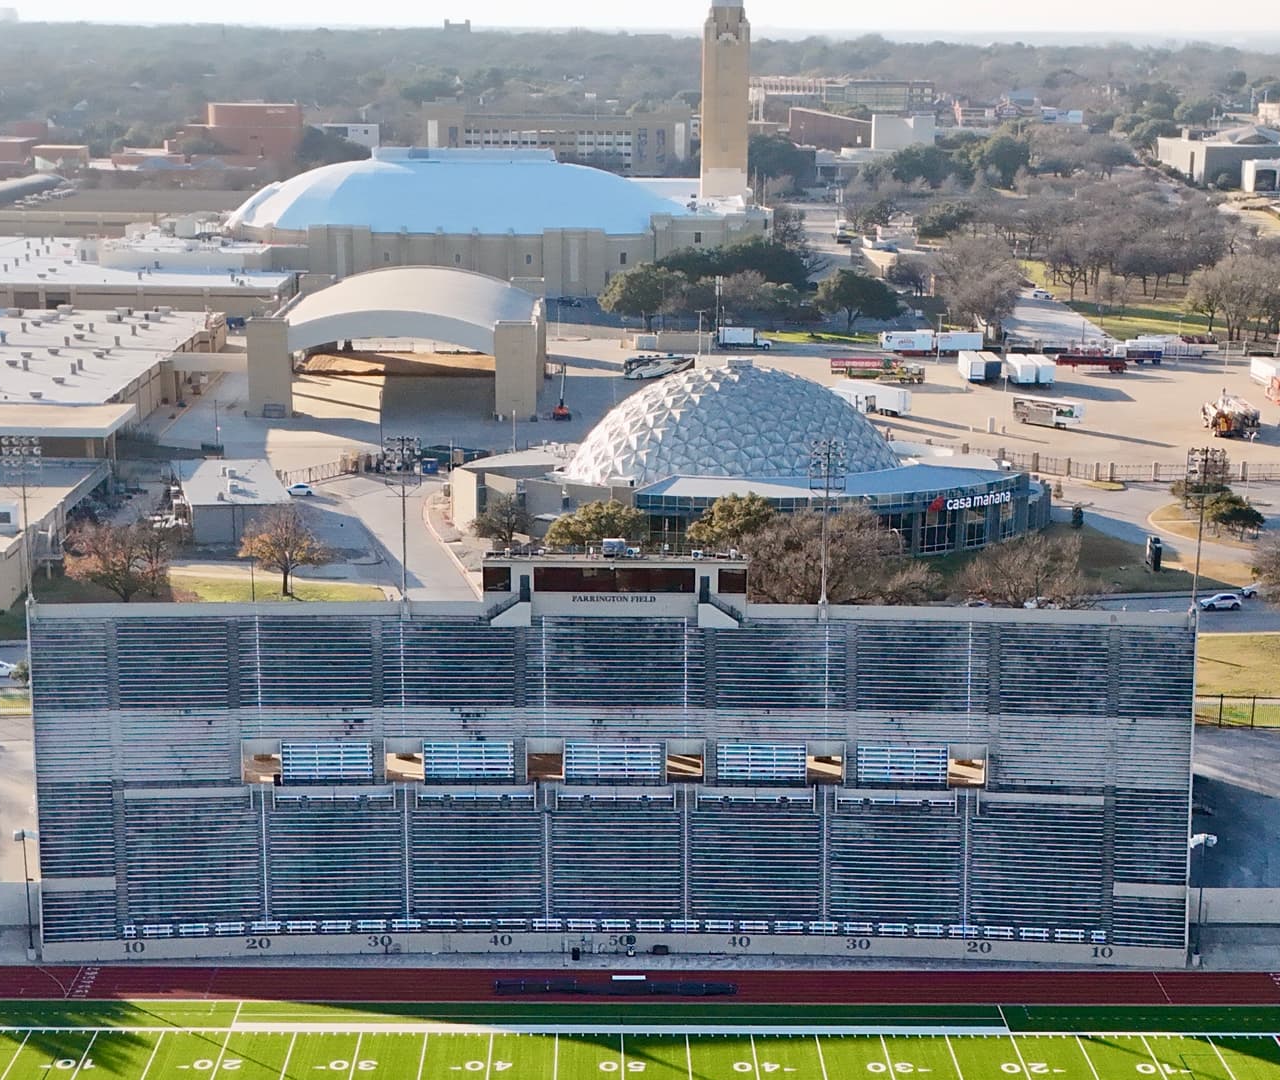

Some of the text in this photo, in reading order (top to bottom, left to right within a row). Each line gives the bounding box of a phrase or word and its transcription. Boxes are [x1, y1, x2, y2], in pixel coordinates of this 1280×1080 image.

[946, 491, 1011, 510] casa mañana
[571, 595, 657, 603] FARRINGTON FIELD
[246, 937, 271, 949] 20
[367, 935, 393, 947] 30
[488, 934, 513, 946] 40
[728, 936, 751, 948] 40
[846, 938, 870, 950] 30
[123, 941, 146, 953] 10
[967, 941, 992, 953] 20
[1090, 946, 1113, 958] 10
[55, 1058, 95, 1069] 10
[193, 1059, 241, 1070] 20
[329, 1059, 377, 1070] 30
[465, 1060, 513, 1070] 40
[599, 1060, 645, 1071] 50
[733, 1061, 780, 1072] 40
[868, 1062, 915, 1073] 30
[1001, 1062, 1049, 1074] 20
[1136, 1063, 1177, 1074] 10
